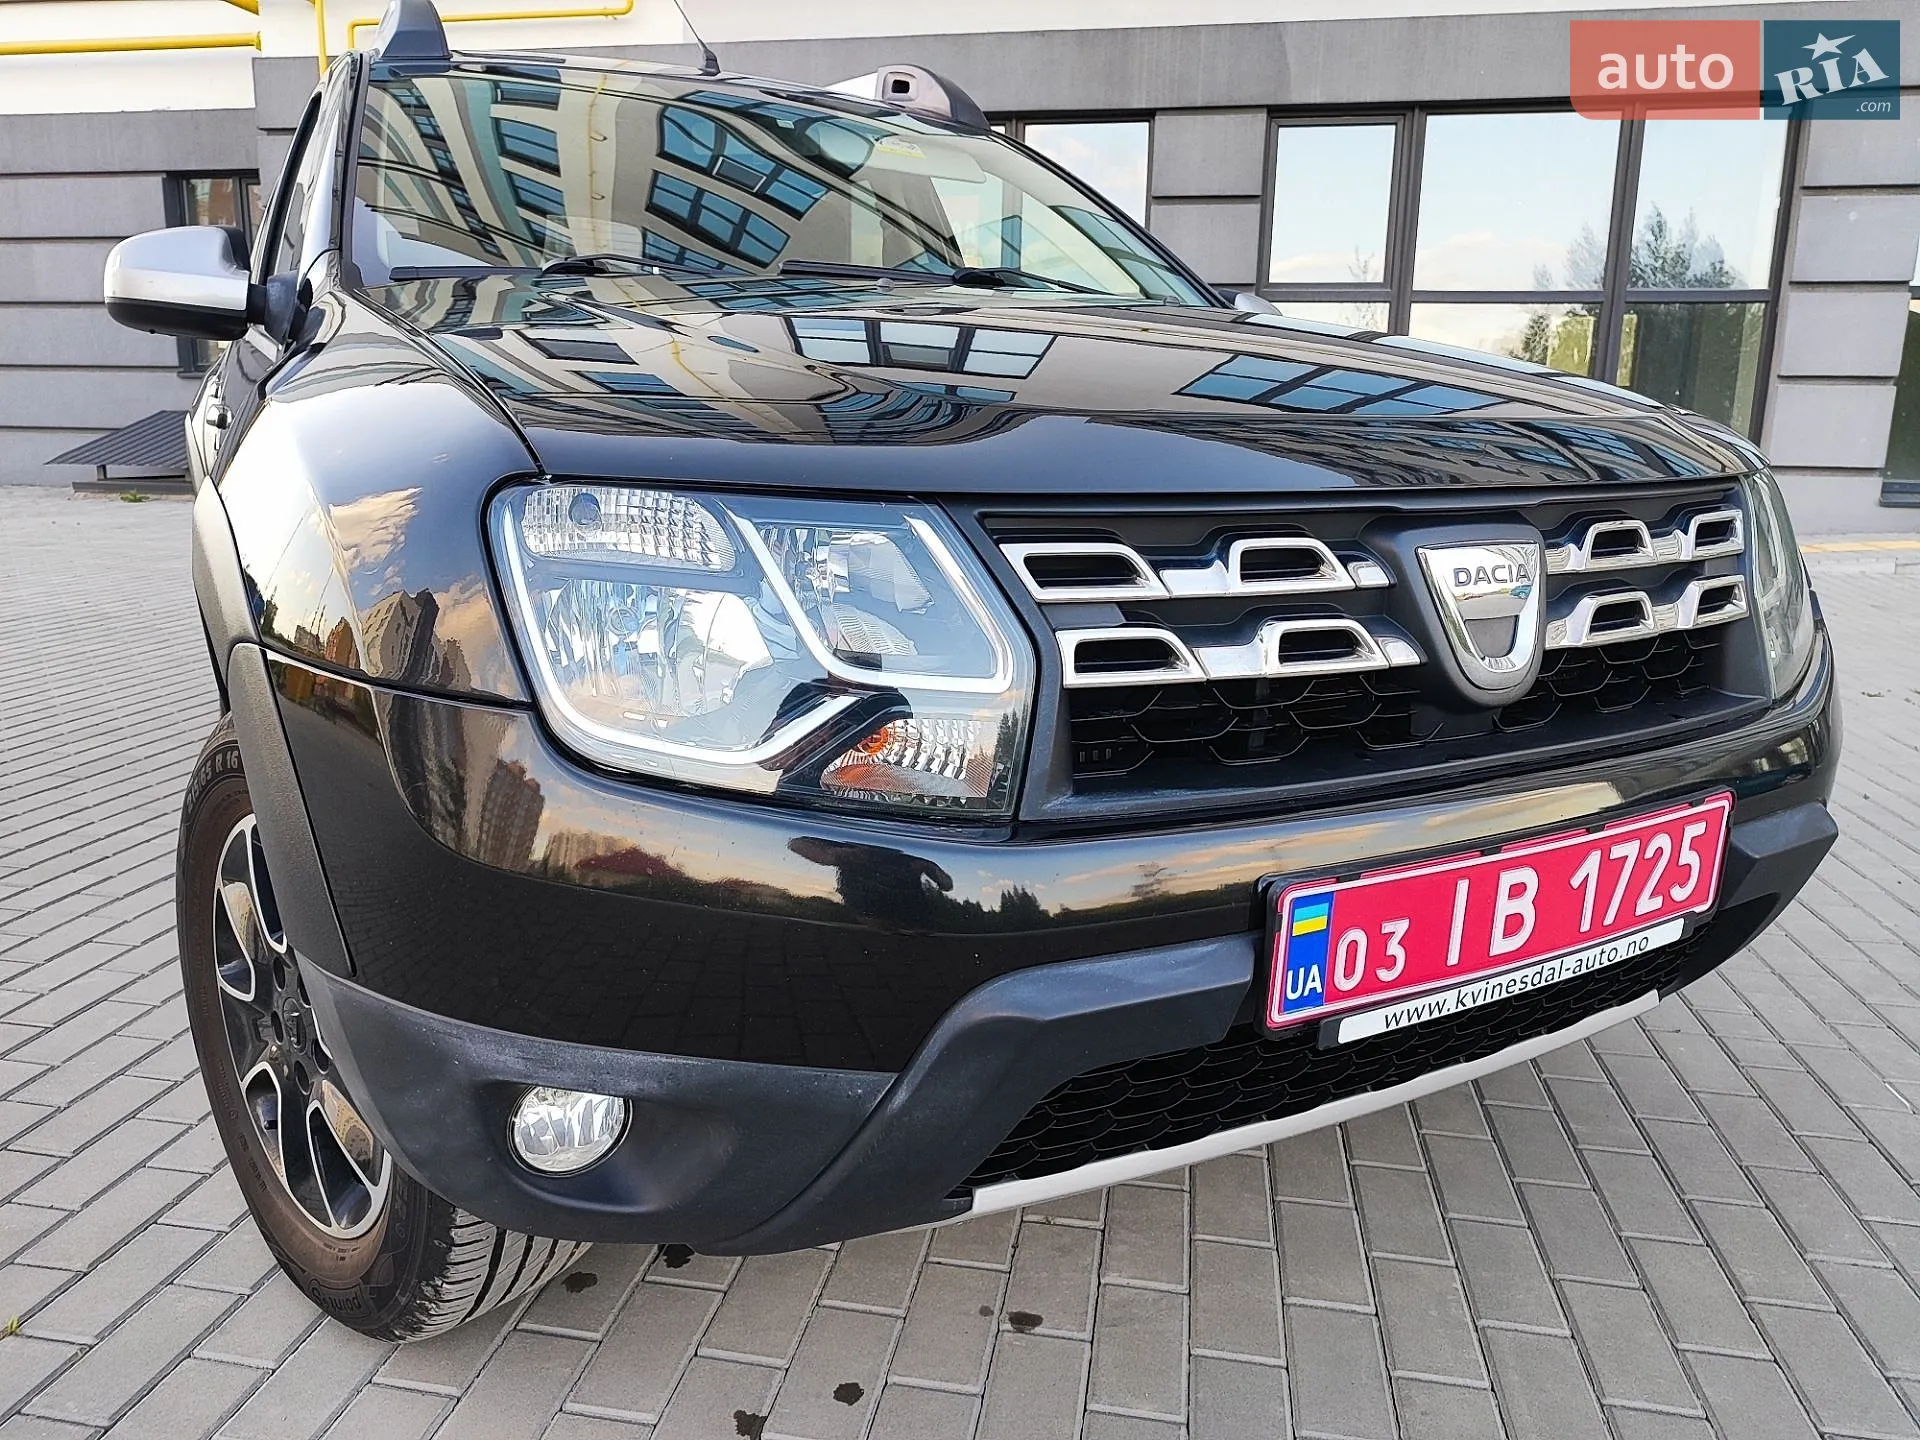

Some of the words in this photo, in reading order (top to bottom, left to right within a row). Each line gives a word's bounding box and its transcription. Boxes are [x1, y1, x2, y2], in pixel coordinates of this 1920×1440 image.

[1453, 563, 1531, 587] DACIA
[215, 752, 224, 774] R
[226, 750, 239, 769] 16
[1333, 917, 1411, 993] 03
[1569, 820, 1708, 934] 1725
[1285, 963, 1323, 1001] UA
[1384, 934, 1650, 1030] www.kvinesdal-auto.no
